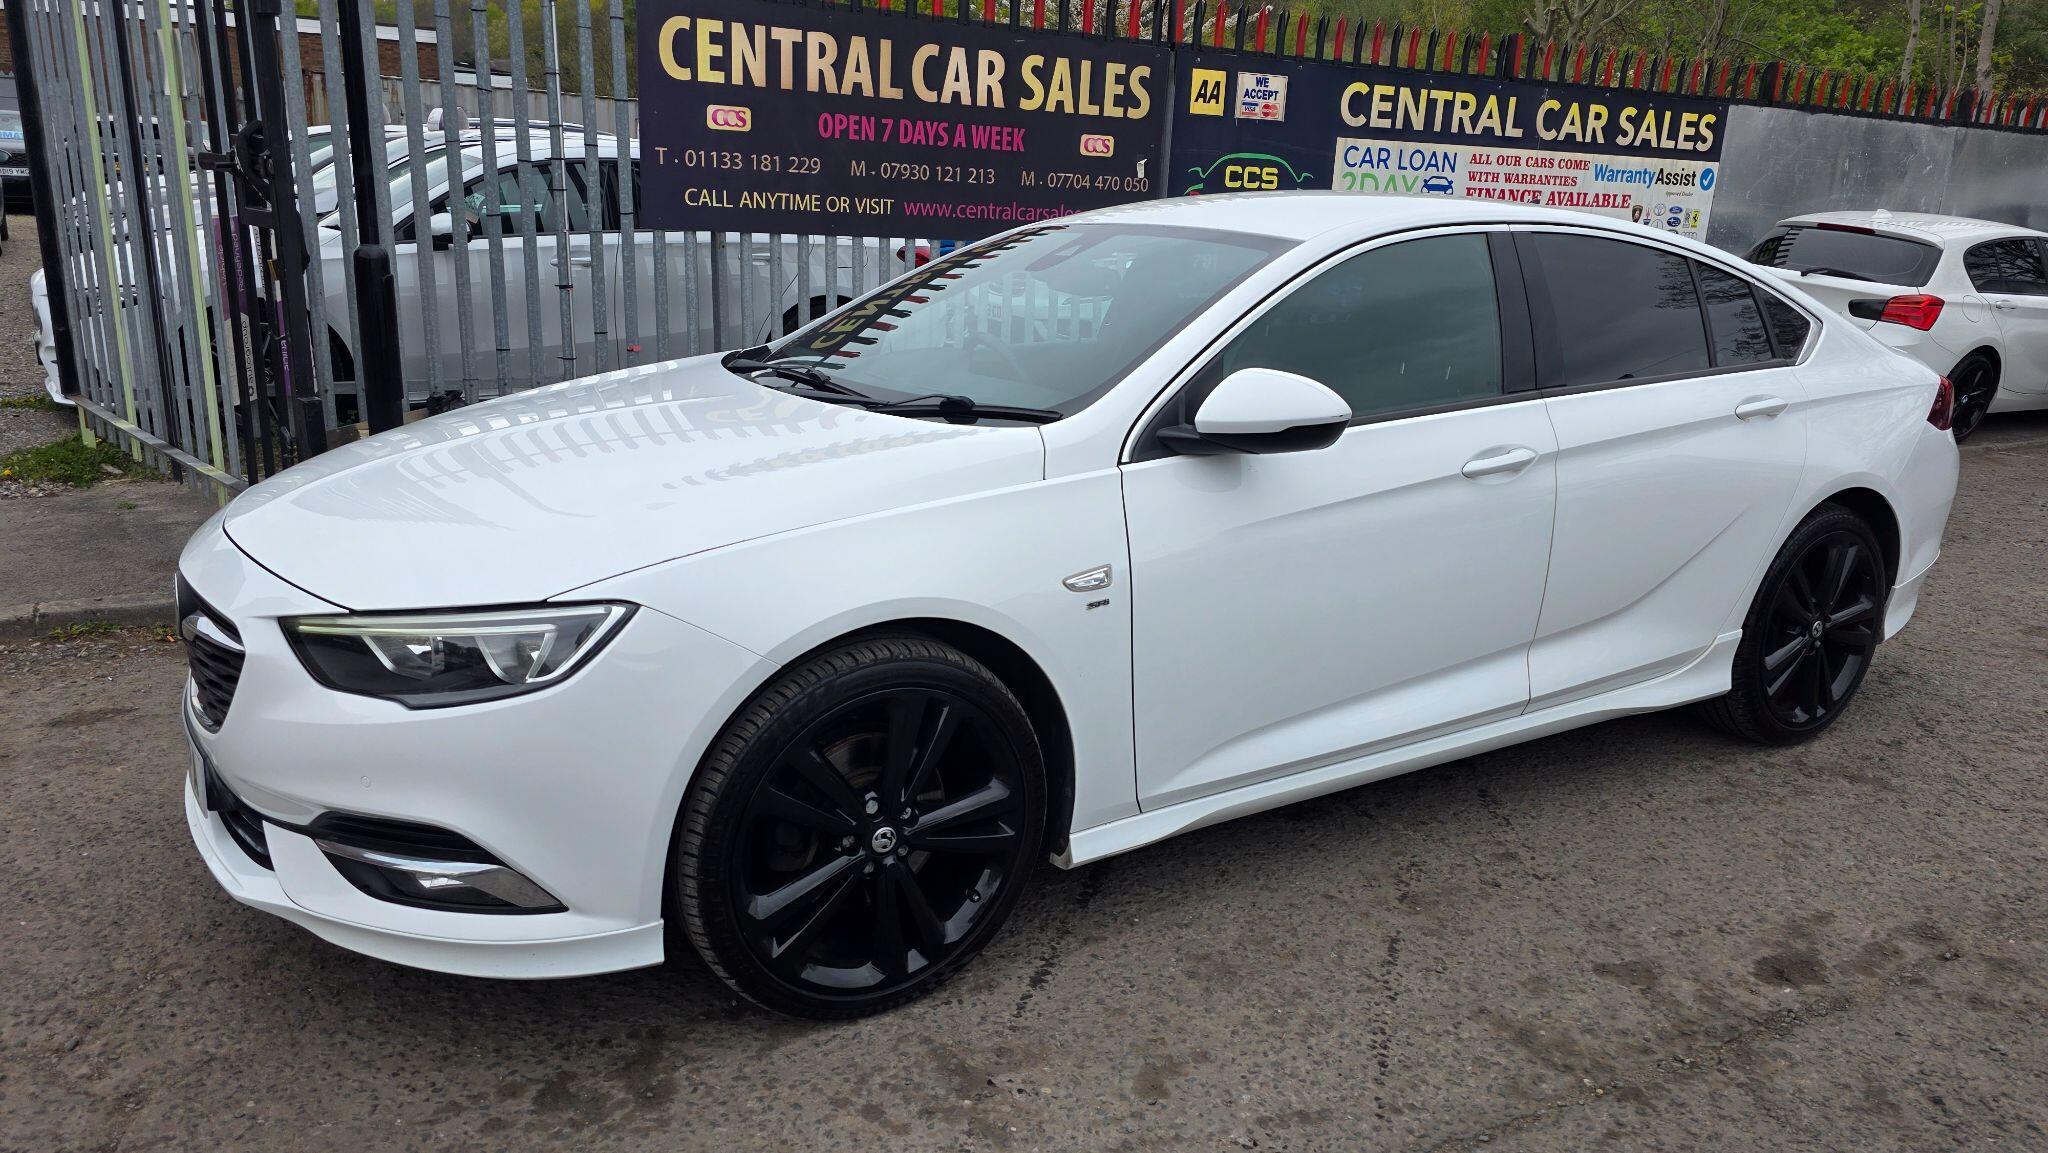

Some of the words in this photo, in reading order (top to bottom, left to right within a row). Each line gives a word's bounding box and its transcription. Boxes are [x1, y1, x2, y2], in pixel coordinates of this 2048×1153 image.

[658, 15, 904, 100] CENTRAL
[911, 43, 1006, 109] CAR
[1019, 54, 1151, 120] SALES
[1194, 79, 1222, 104] AA
[1243, 88, 1279, 101] ACCEPT
[1255, 76, 1270, 88] WE
[711, 108, 747, 128] CCS
[1340, 81, 1524, 138] CENTRAL
[1536, 98, 1609, 144] CAR
[1616, 106, 1717, 152] SALES
[818, 112, 875, 142] OPEN
[881, 118, 894, 142] 7
[900, 119, 949, 147] DAYS
[953, 123, 967, 148] A
[971, 124, 1026, 152] WEEK
[685, 150, 743, 170] 01133
[751, 154, 780, 172] 181
[788, 156, 821, 174] 229
[880, 162, 930, 181] 07930
[936, 166, 961, 182] 121
[967, 168, 995, 184] 213
[1047, 173, 1091, 189] 07704
[1095, 175, 1120, 191] 470
[1124, 177, 1149, 192] 050
[1344, 145, 1391, 170] CAR
[1398, 148, 1458, 173] LOAN
[1469, 153, 1492, 165] ALL
[1496, 154, 1522, 168] OUR
[1525, 156, 1554, 169] CARS
[1558, 158, 1591, 171] COME
[1225, 165, 1279, 190] CCS
[1468, 170, 1500, 184] WITH
[1503, 172, 1578, 187] WARRANTIES
[684, 187, 734, 208] CALL
[739, 191, 821, 212] ANYTIME
[826, 196, 850, 213] OR
[854, 197, 895, 215] VISIT
[1545, 190, 1632, 209] AVAILABLE
